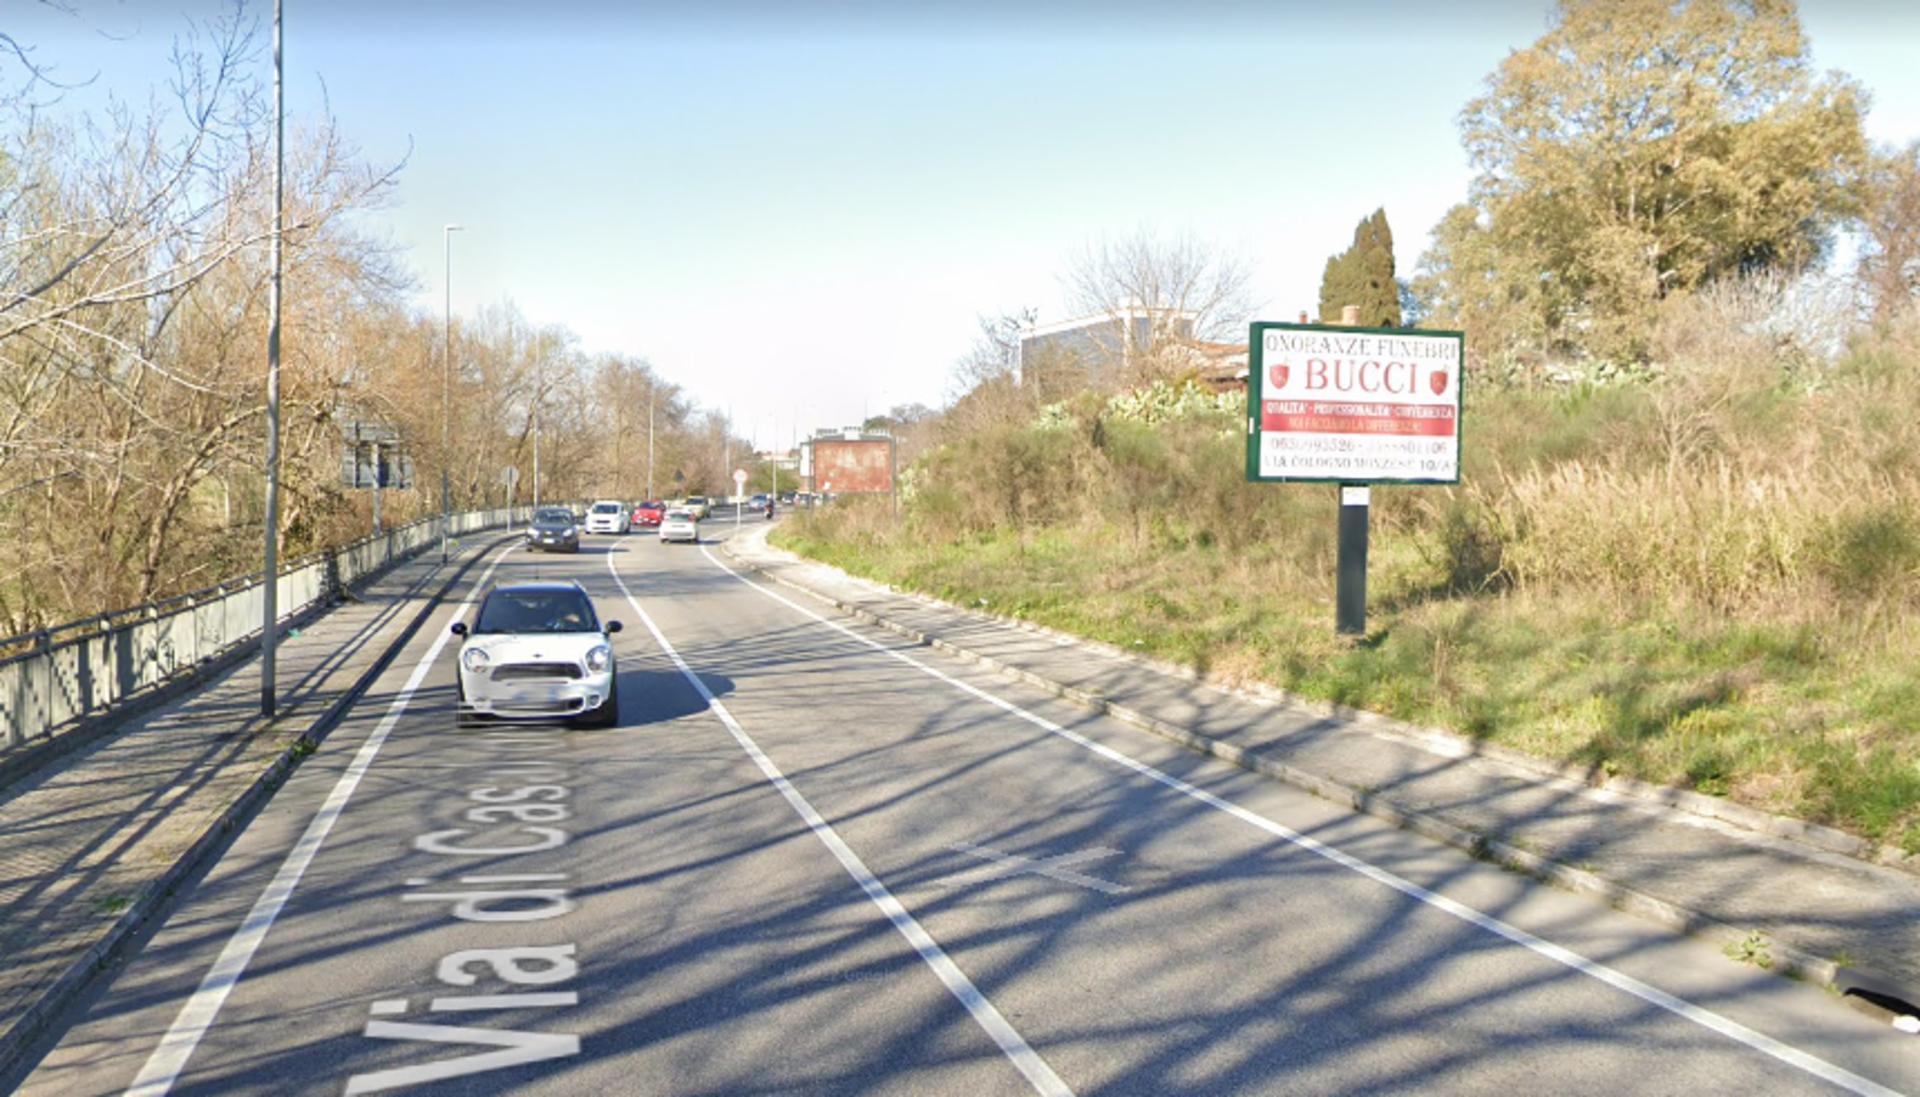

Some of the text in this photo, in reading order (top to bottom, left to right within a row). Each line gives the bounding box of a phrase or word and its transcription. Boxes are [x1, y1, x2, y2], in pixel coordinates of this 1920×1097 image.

[1266, 334, 1456, 361] ONORANZE FUNEBRI
[1305, 357, 1417, 394] BUCCI
